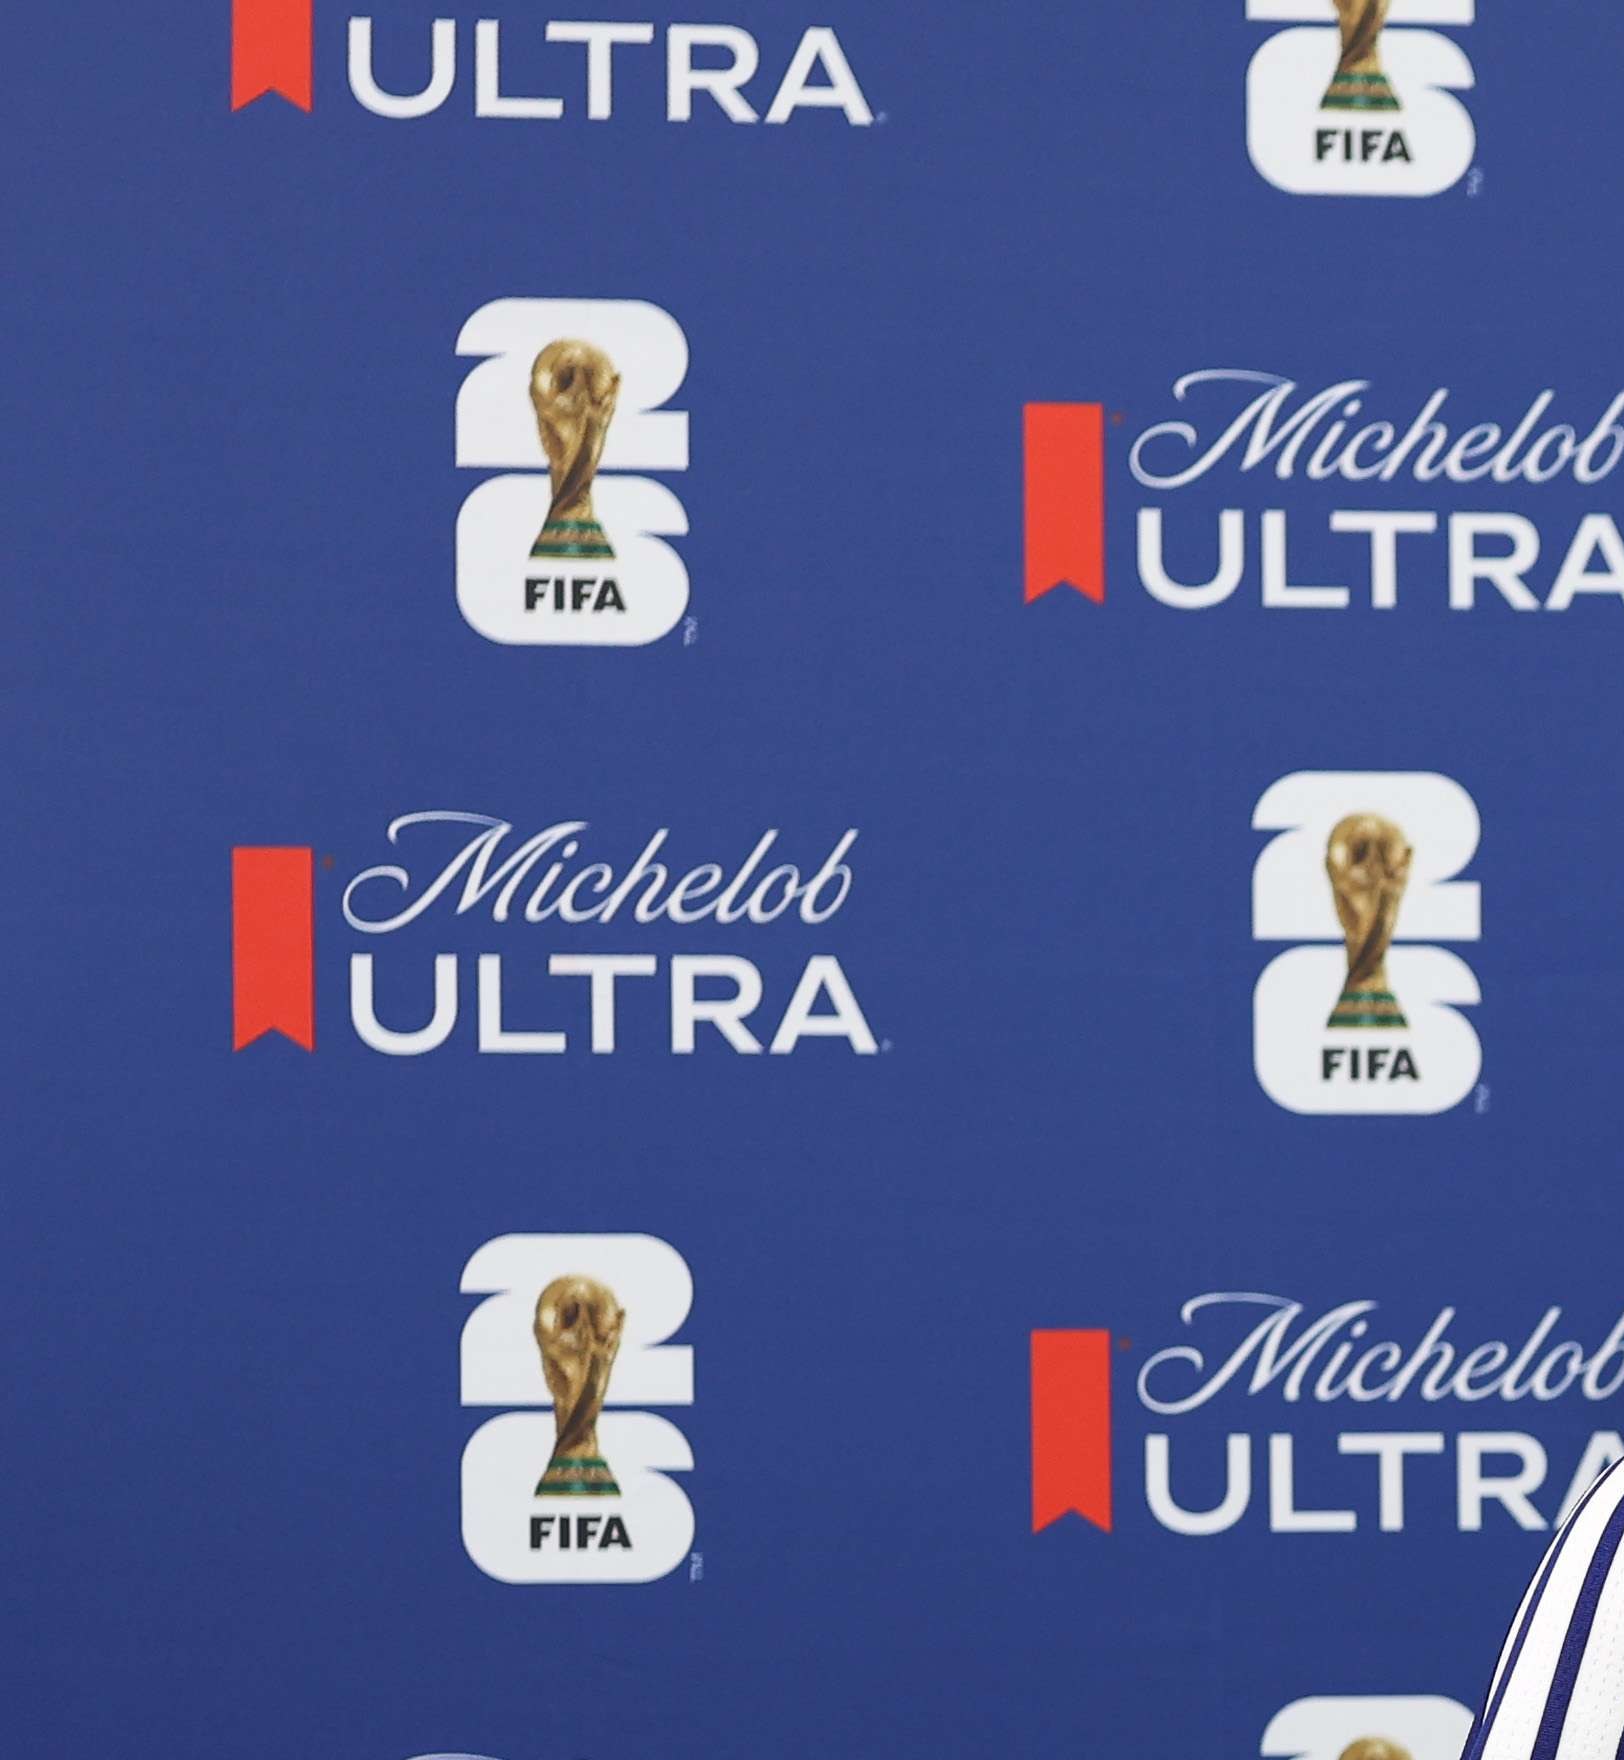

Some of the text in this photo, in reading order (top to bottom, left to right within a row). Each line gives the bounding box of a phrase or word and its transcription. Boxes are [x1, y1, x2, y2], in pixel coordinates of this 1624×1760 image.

[349, 17, 873, 125] ULTRA
[1316, 130, 1411, 162] FIFA
[525, 579, 625, 611] FIFA
[343, 812, 857, 933] Michelob
[351, 954, 877, 1055] ULTRA
[1323, 1049, 1418, 1080] FIFA
[530, 1517, 631, 1549] FIFA
